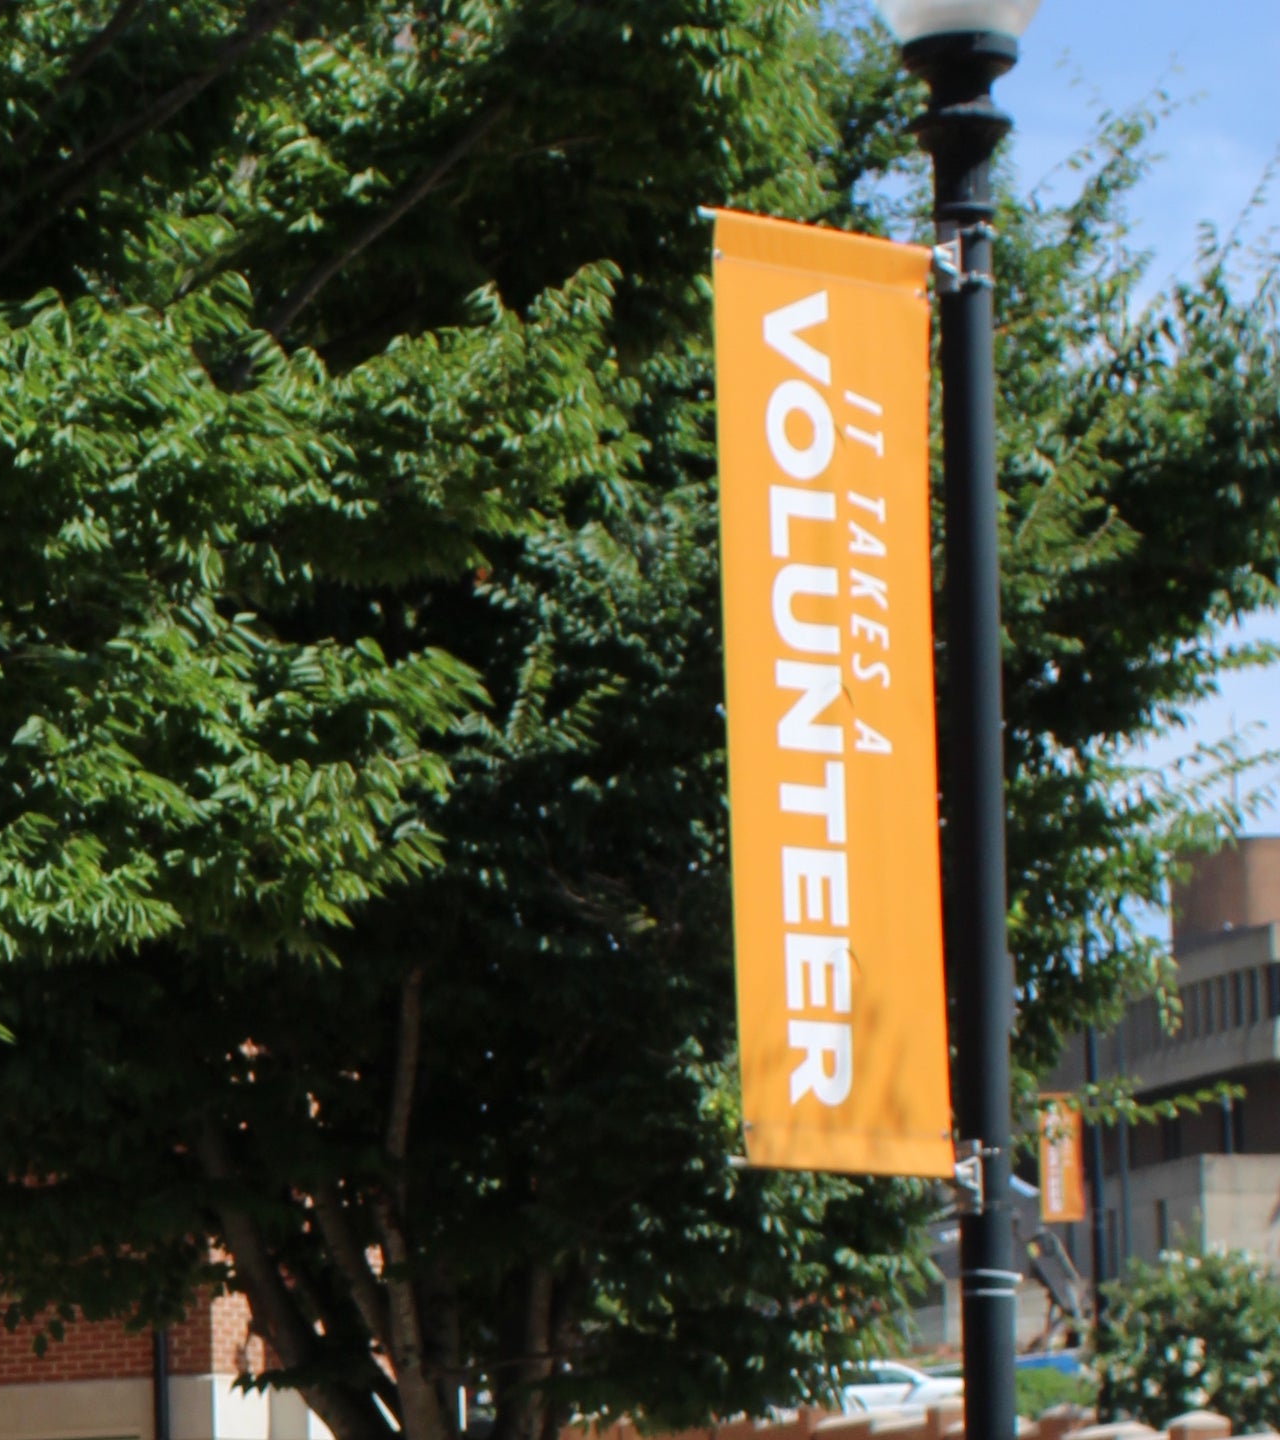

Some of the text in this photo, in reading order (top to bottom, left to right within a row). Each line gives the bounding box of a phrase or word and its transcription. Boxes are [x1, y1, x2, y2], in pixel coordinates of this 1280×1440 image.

[761, 290, 853, 1107] VOLUNTEER
[843, 389, 893, 756] IT TAKES A
